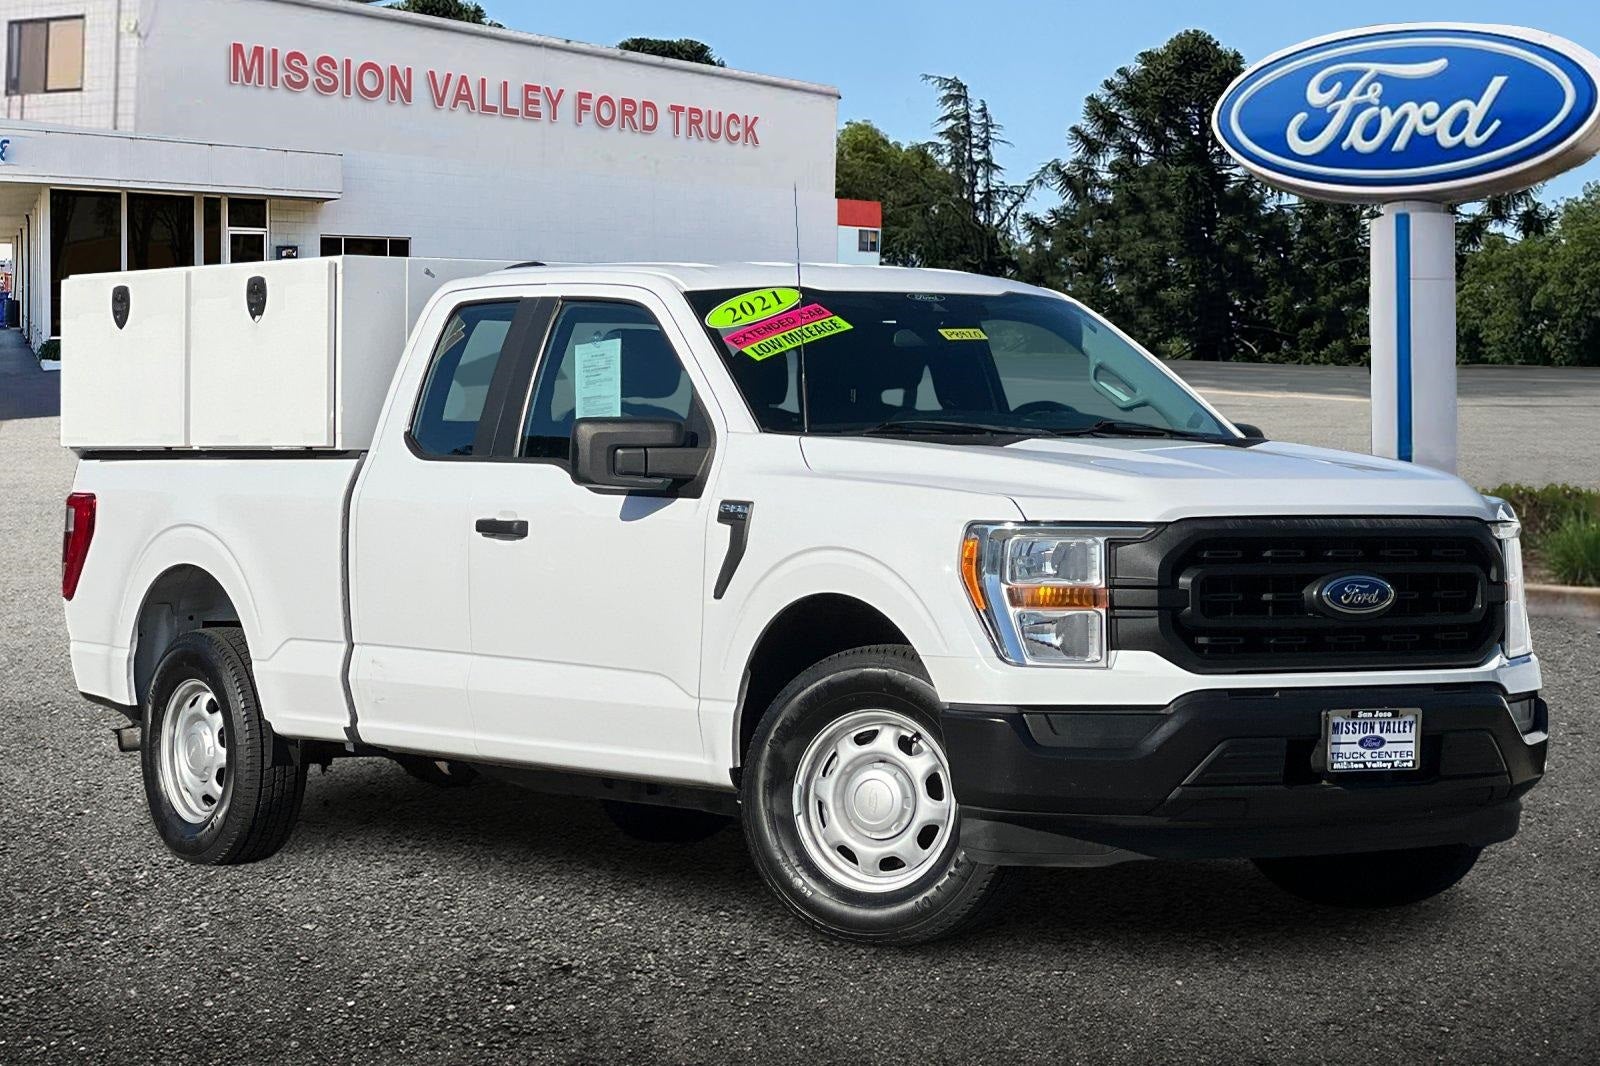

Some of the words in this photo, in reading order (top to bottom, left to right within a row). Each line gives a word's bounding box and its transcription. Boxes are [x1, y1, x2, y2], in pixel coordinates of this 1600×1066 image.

[228, 41, 413, 105] MISSION
[427, 69, 565, 121] VALLEY
[575, 90, 660, 134] FORD
[669, 103, 761, 146] TRUCK
[1286, 57, 1509, 156] Ford
[723, 290, 783, 324] 2021
[731, 316, 797, 346] EXTENDED
[750, 337, 784, 357] LOW
[781, 318, 841, 346] MILEAGE
[1341, 583, 1380, 604] Ford
[1357, 710, 1373, 718] San
[1373, 710, 1393, 718] Jose
[1331, 721, 1376, 735] MISSION
[1379, 720, 1415, 734] VALLEY
[1331, 751, 1366, 760] TRUCK
[1370, 750, 1413, 759] CENTER
[1366, 761, 1391, 769] Valley
